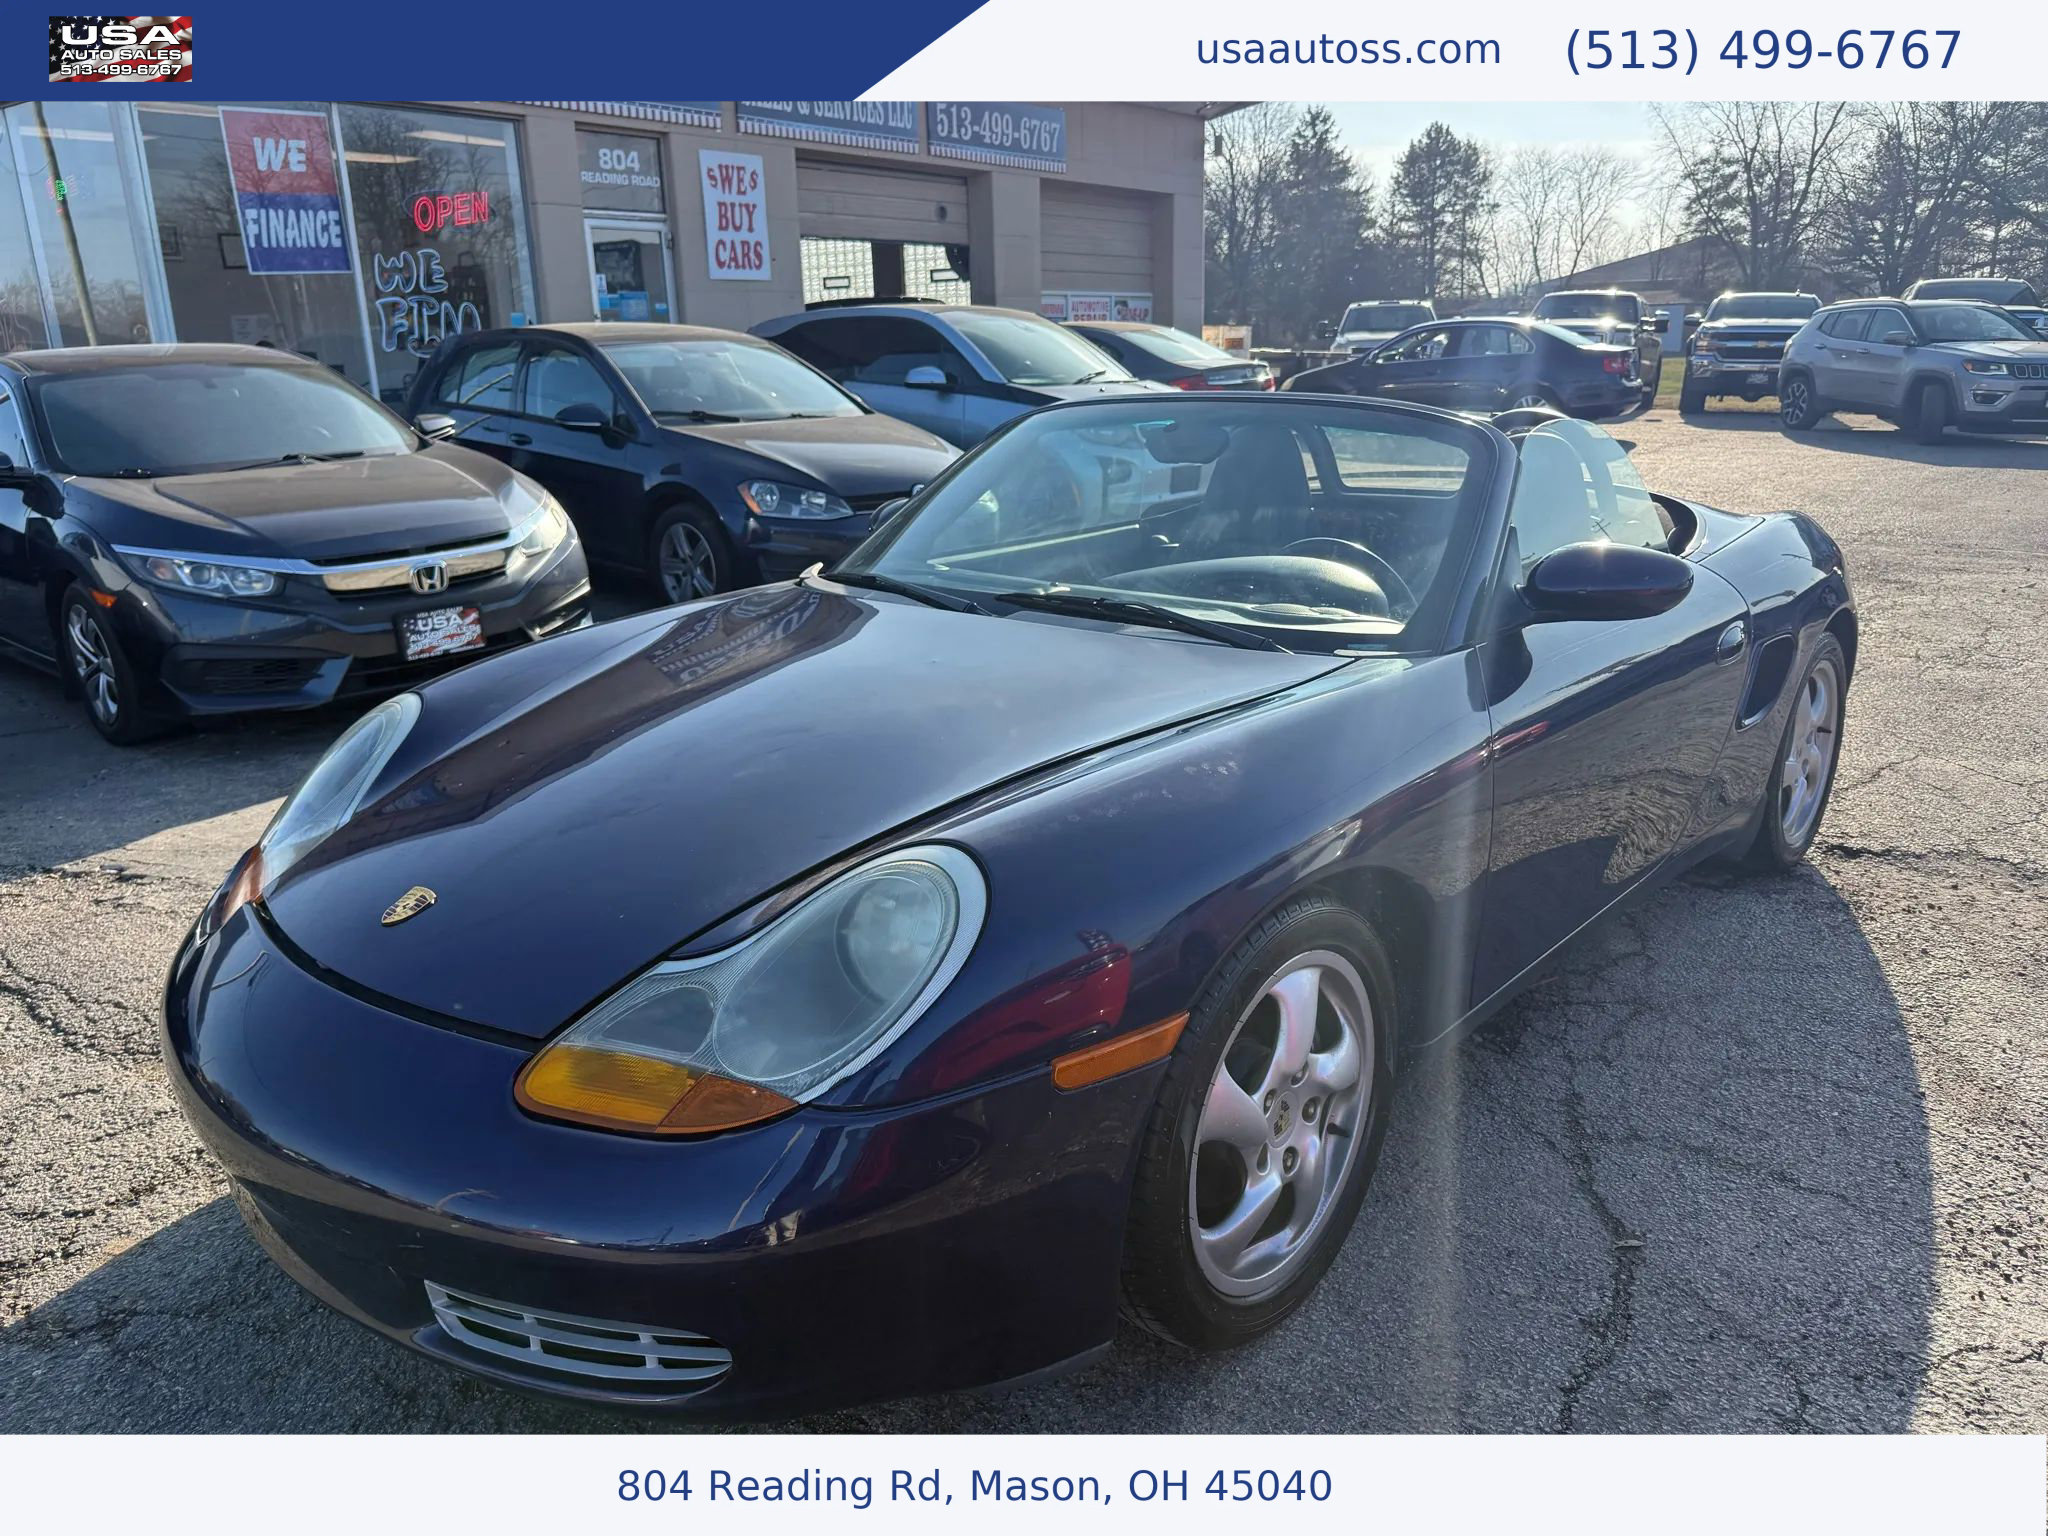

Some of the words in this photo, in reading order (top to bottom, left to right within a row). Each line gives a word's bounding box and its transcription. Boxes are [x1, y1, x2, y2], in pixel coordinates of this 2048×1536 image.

[936, 102, 1060, 153] 513-499-6767
[253, 136, 307, 172] WE
[598, 148, 641, 172] 804
[580, 171, 630, 186] READING
[631, 174, 661, 188] ROAD
[414, 191, 489, 232] OPEN
[717, 201, 757, 233] BUY
[244, 208, 342, 249] FINANCE
[374, 248, 449, 294] WE
[715, 239, 763, 271] CARS
[409, 629, 440, 643] AUTO
[416, 613, 463, 632] USA
